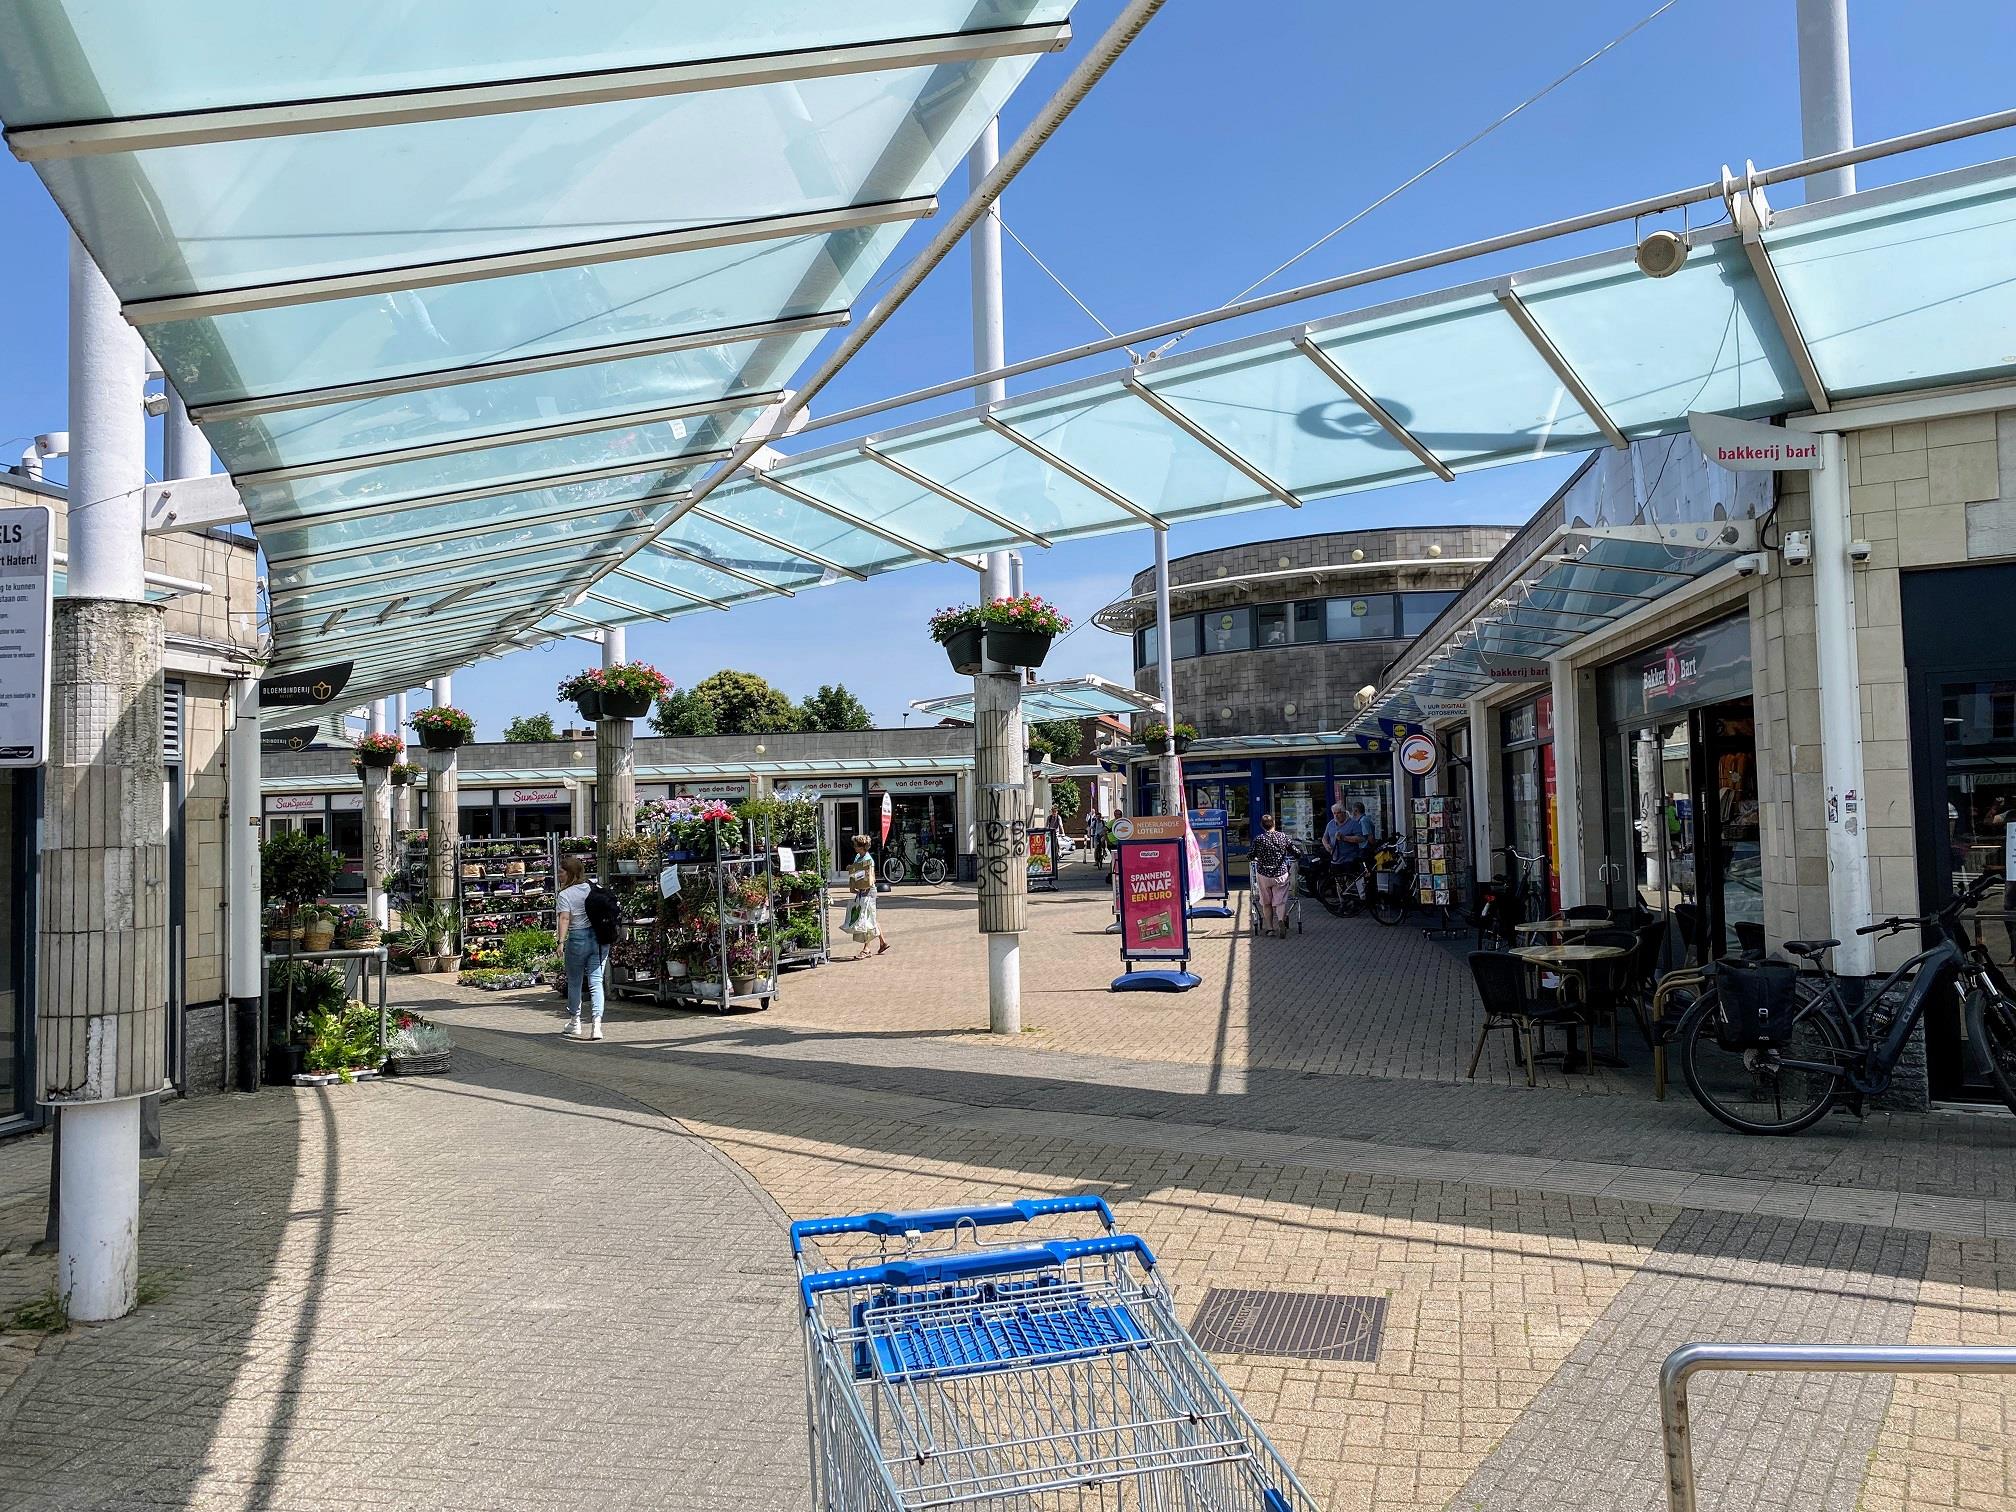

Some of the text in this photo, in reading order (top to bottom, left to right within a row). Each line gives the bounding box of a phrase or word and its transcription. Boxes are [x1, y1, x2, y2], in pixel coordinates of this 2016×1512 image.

[1718, 444, 1816, 461] bakkerij bart
[0, 524, 22, 543] LS
[7, 554, 37, 566] Hatert!
[6, 583, 11, 591] te
[13, 583, 35, 591] kunnen
[1490, 667, 1548, 677] bakkerij bart
[1643, 667, 1666, 689] Bakker
[1680, 656, 1697, 678] Bart
[262, 687, 310, 695] BLOEMBINDERIJ
[726, 784, 745, 793] Bergh
[833, 782, 853, 790] Bergh
[924, 779, 944, 787] Bergh
[1137, 820, 1180, 829] NEDERLANDSE
[1130, 870, 1171, 882] SPANNEND
[1130, 879, 1172, 894] VANAF
[1131, 891, 1172, 903] EEN EURO
